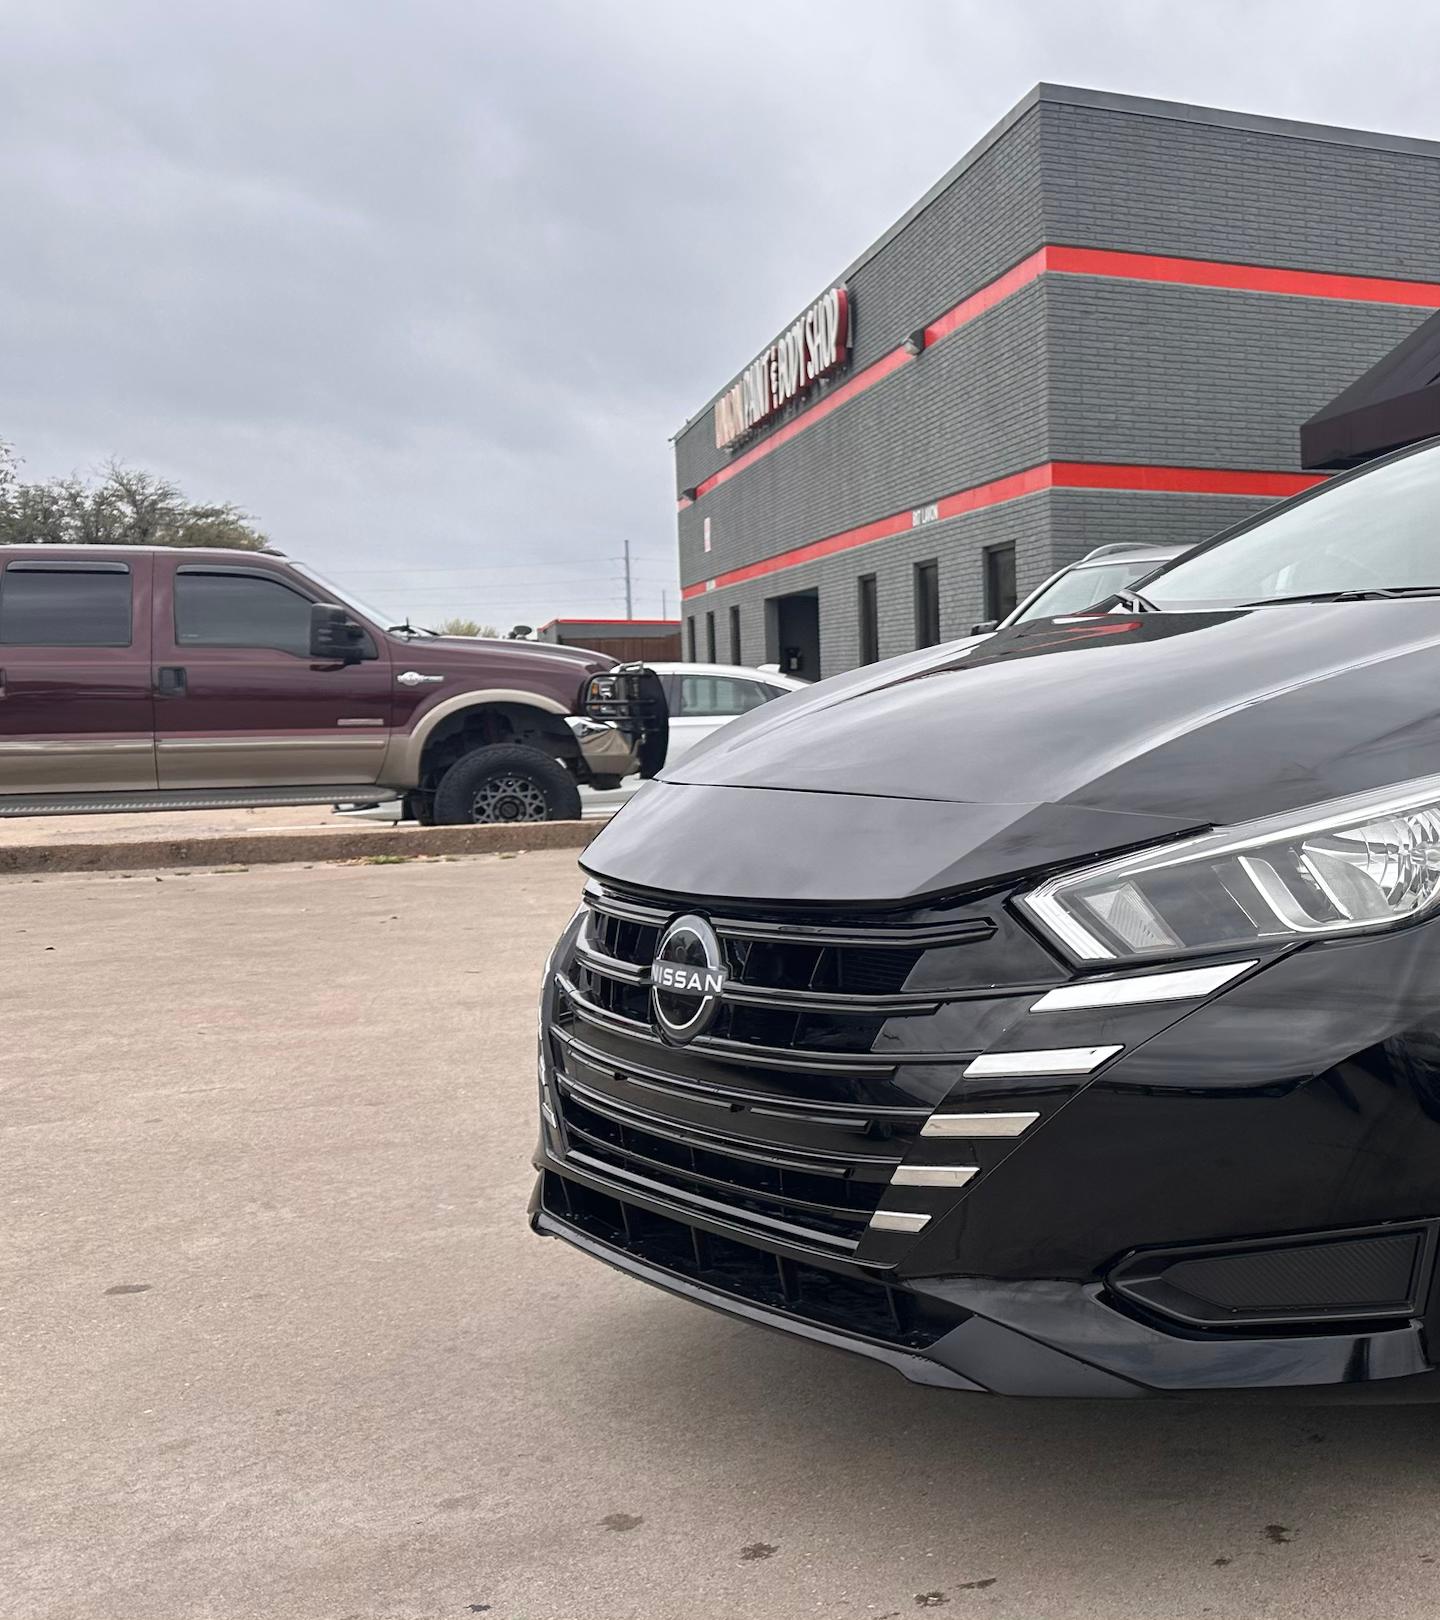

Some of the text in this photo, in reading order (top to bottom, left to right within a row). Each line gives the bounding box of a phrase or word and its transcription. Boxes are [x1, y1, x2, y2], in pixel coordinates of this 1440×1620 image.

[743, 350, 771, 429] PAINT
[778, 316, 806, 406] BODY
[805, 287, 841, 380] SHOP
[651, 963, 723, 993] NISSAN
